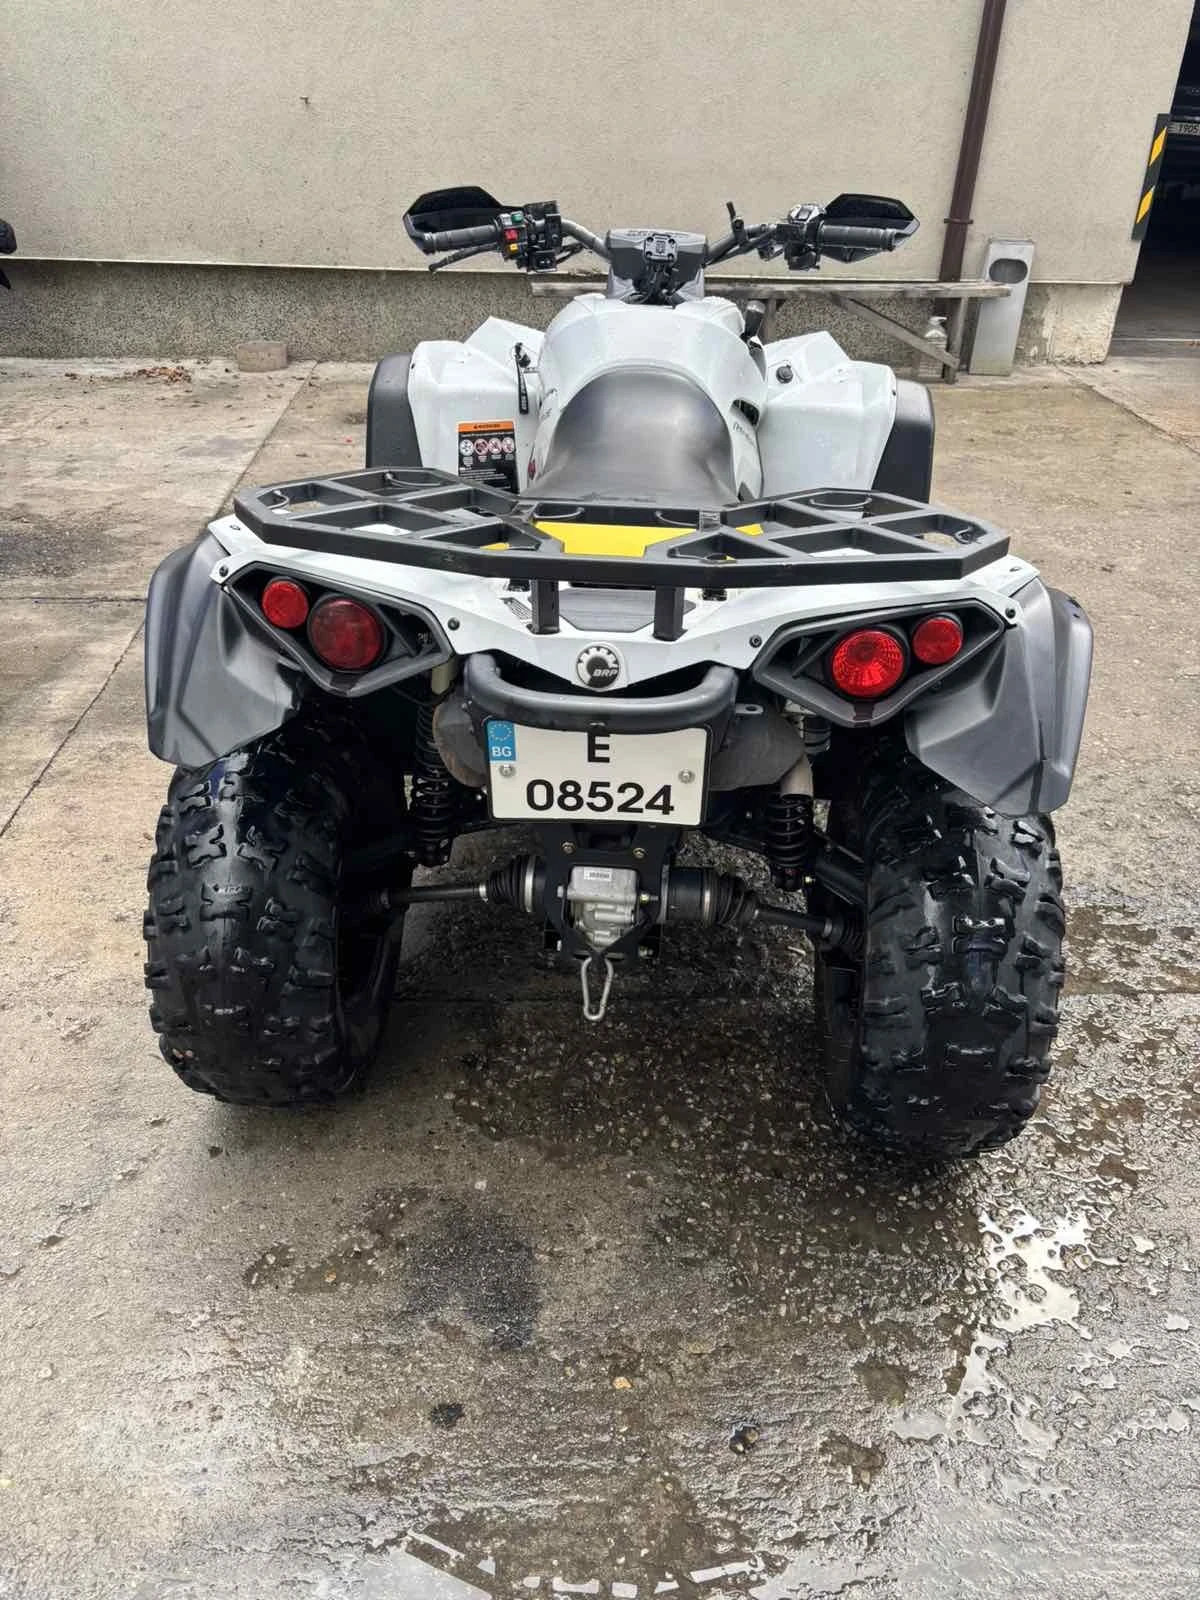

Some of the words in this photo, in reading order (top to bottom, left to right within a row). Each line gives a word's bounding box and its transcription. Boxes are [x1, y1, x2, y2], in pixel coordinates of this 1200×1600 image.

[592, 668, 618, 678] BRP
[491, 746, 513, 758] BG
[587, 730, 611, 763] E
[526, 779, 675, 815] 08524
